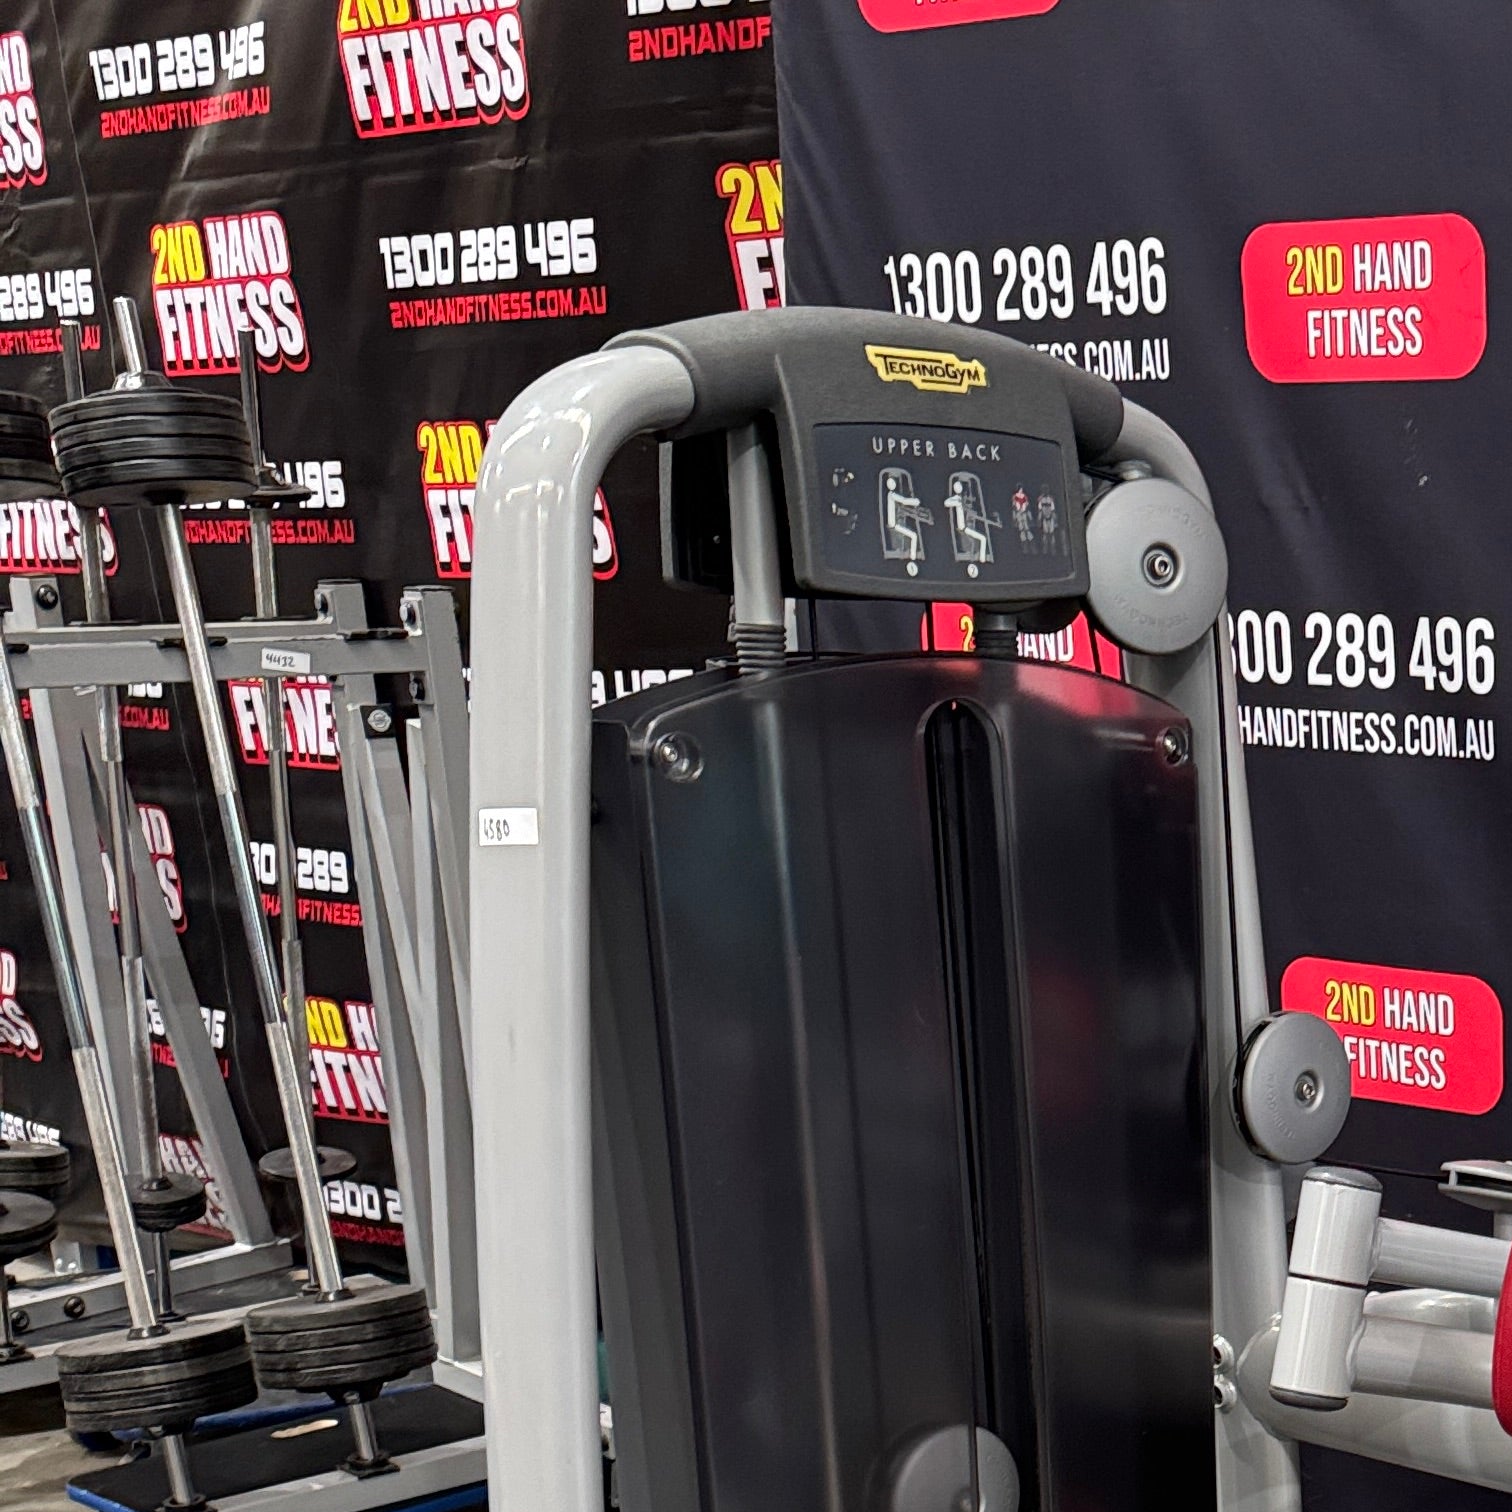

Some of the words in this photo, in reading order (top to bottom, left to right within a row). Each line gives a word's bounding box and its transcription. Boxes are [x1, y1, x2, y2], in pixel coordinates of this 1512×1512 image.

[89, 43, 152, 100] 1300
[156, 33, 215, 92] 289
[218, 20, 265, 80] 496
[342, 14, 527, 121] FITNESS
[101, 86, 270, 139] 2NDHANDFITNESS.COM.AU
[153, 225, 205, 284] 2ND
[206, 215, 289, 279] HAND
[379, 232, 454, 289] 1300
[460, 225, 518, 283] 289
[524, 218, 597, 277] 496
[1286, 246, 1344, 295] 2ND
[1353, 240, 1432, 292] HAND
[45, 268, 95, 317] 496
[389, 286, 607, 328] 2NDHANDFITNESS.COM.AU
[884, 250, 982, 324] 1300
[993, 244, 1074, 321] 289
[1086, 237, 1167, 317] 496
[156, 278, 303, 362] FITNESS
[1307, 307, 1422, 358] FITNESS
[420, 425, 483, 484] 2ND
[872, 437, 935, 457] UPPER
[948, 442, 1001, 461] BACK
[1228, 609, 1293, 684] 00
[1305, 611, 1396, 690] 289
[1409, 616, 1495, 695] 496
[1238, 705, 1494, 762] HANDFITNESS.COM.AU
[297, 847, 349, 894] 289
[1325, 980, 1375, 1026] 2ND
[1383, 987, 1454, 1036] HAND
